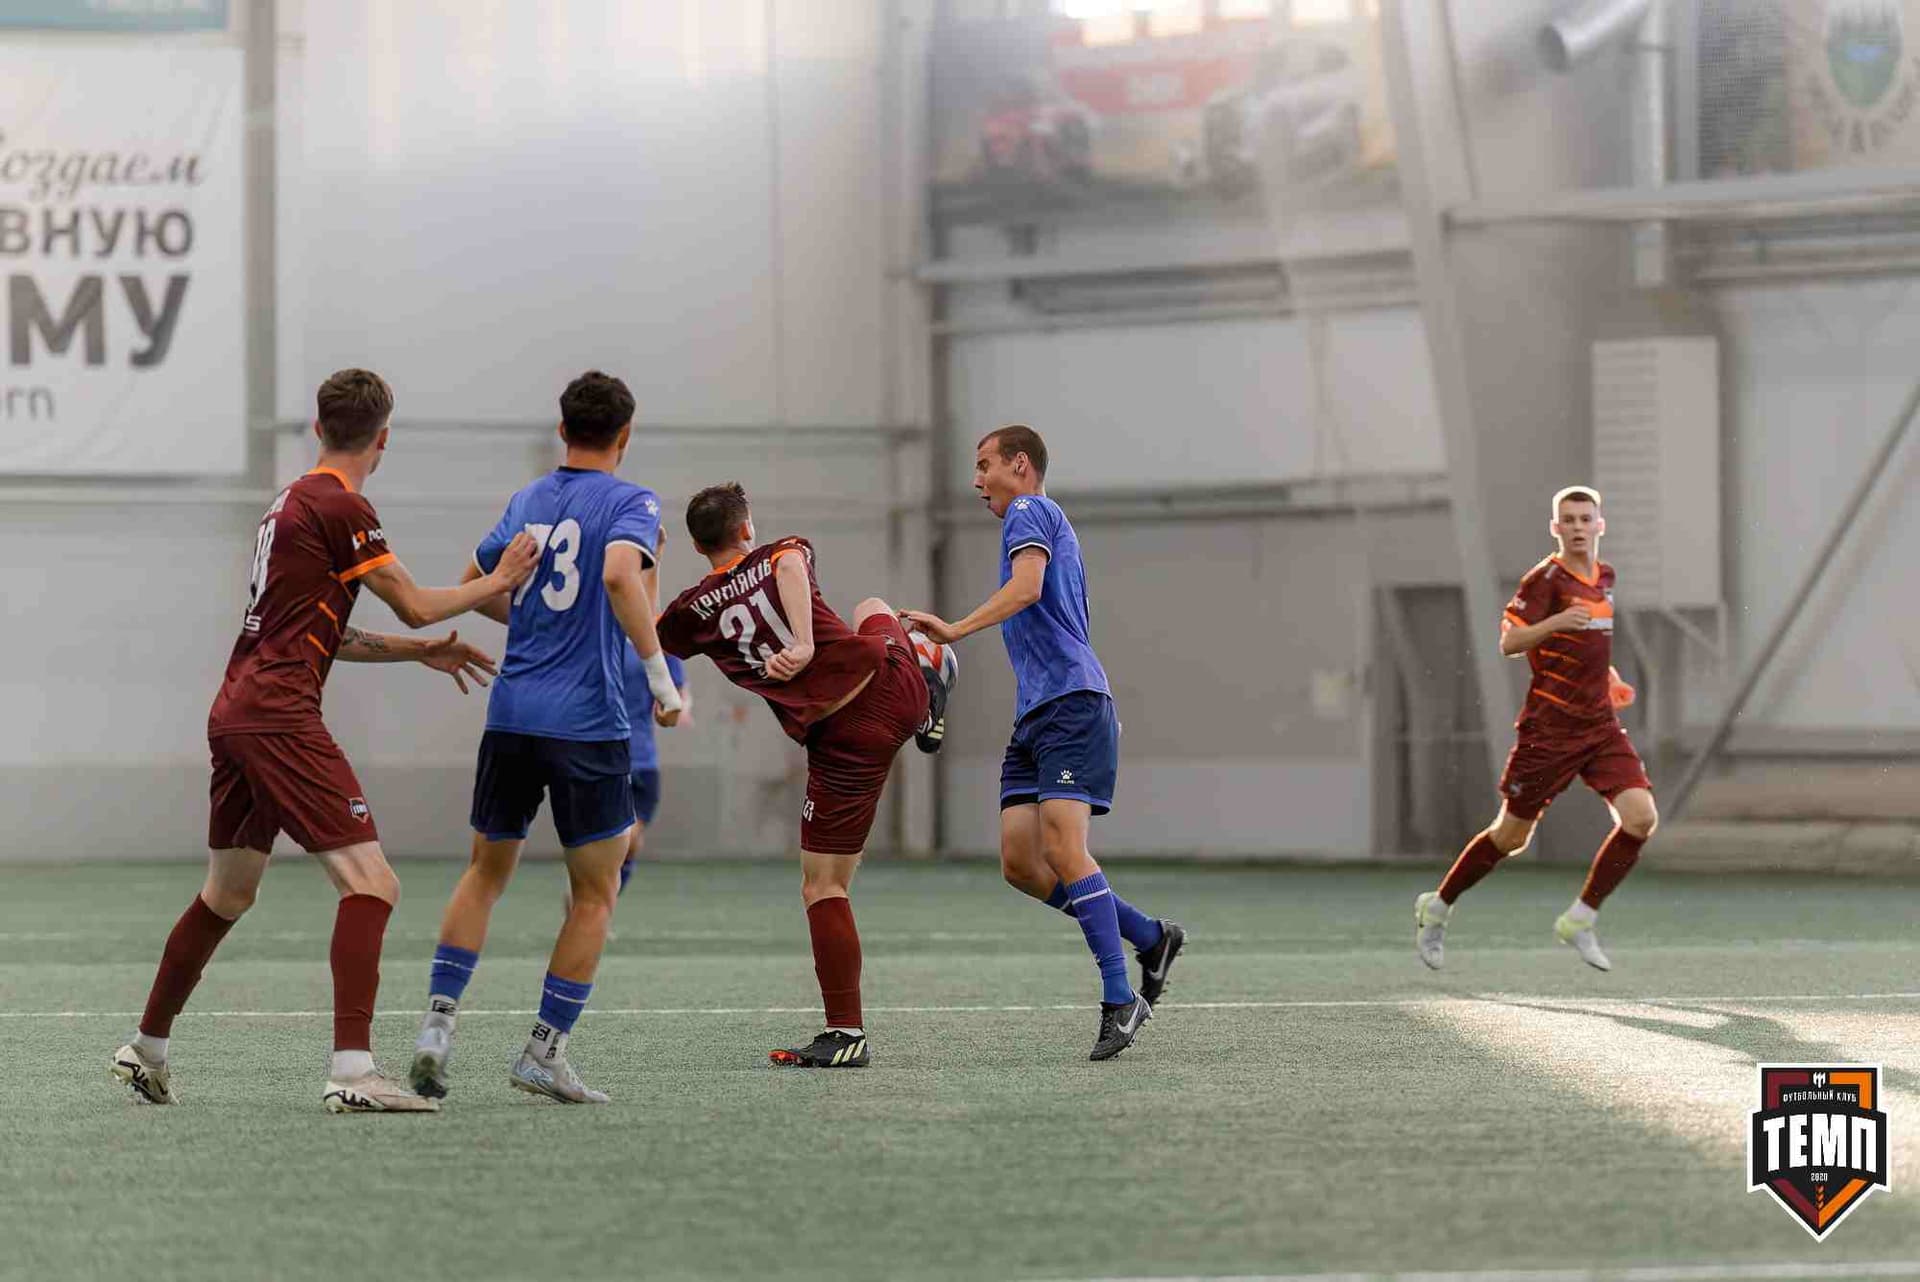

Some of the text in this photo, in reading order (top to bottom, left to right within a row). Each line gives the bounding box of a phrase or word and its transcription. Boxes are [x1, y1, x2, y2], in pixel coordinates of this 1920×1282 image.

[0, 136, 206, 199] оздаем
[0, 208, 194, 257] ВНУЮ
[8, 274, 191, 369] МУ
[0, 385, 55, 420] rn
[513, 518, 581, 612] 73
[719, 588, 799, 669] 21
